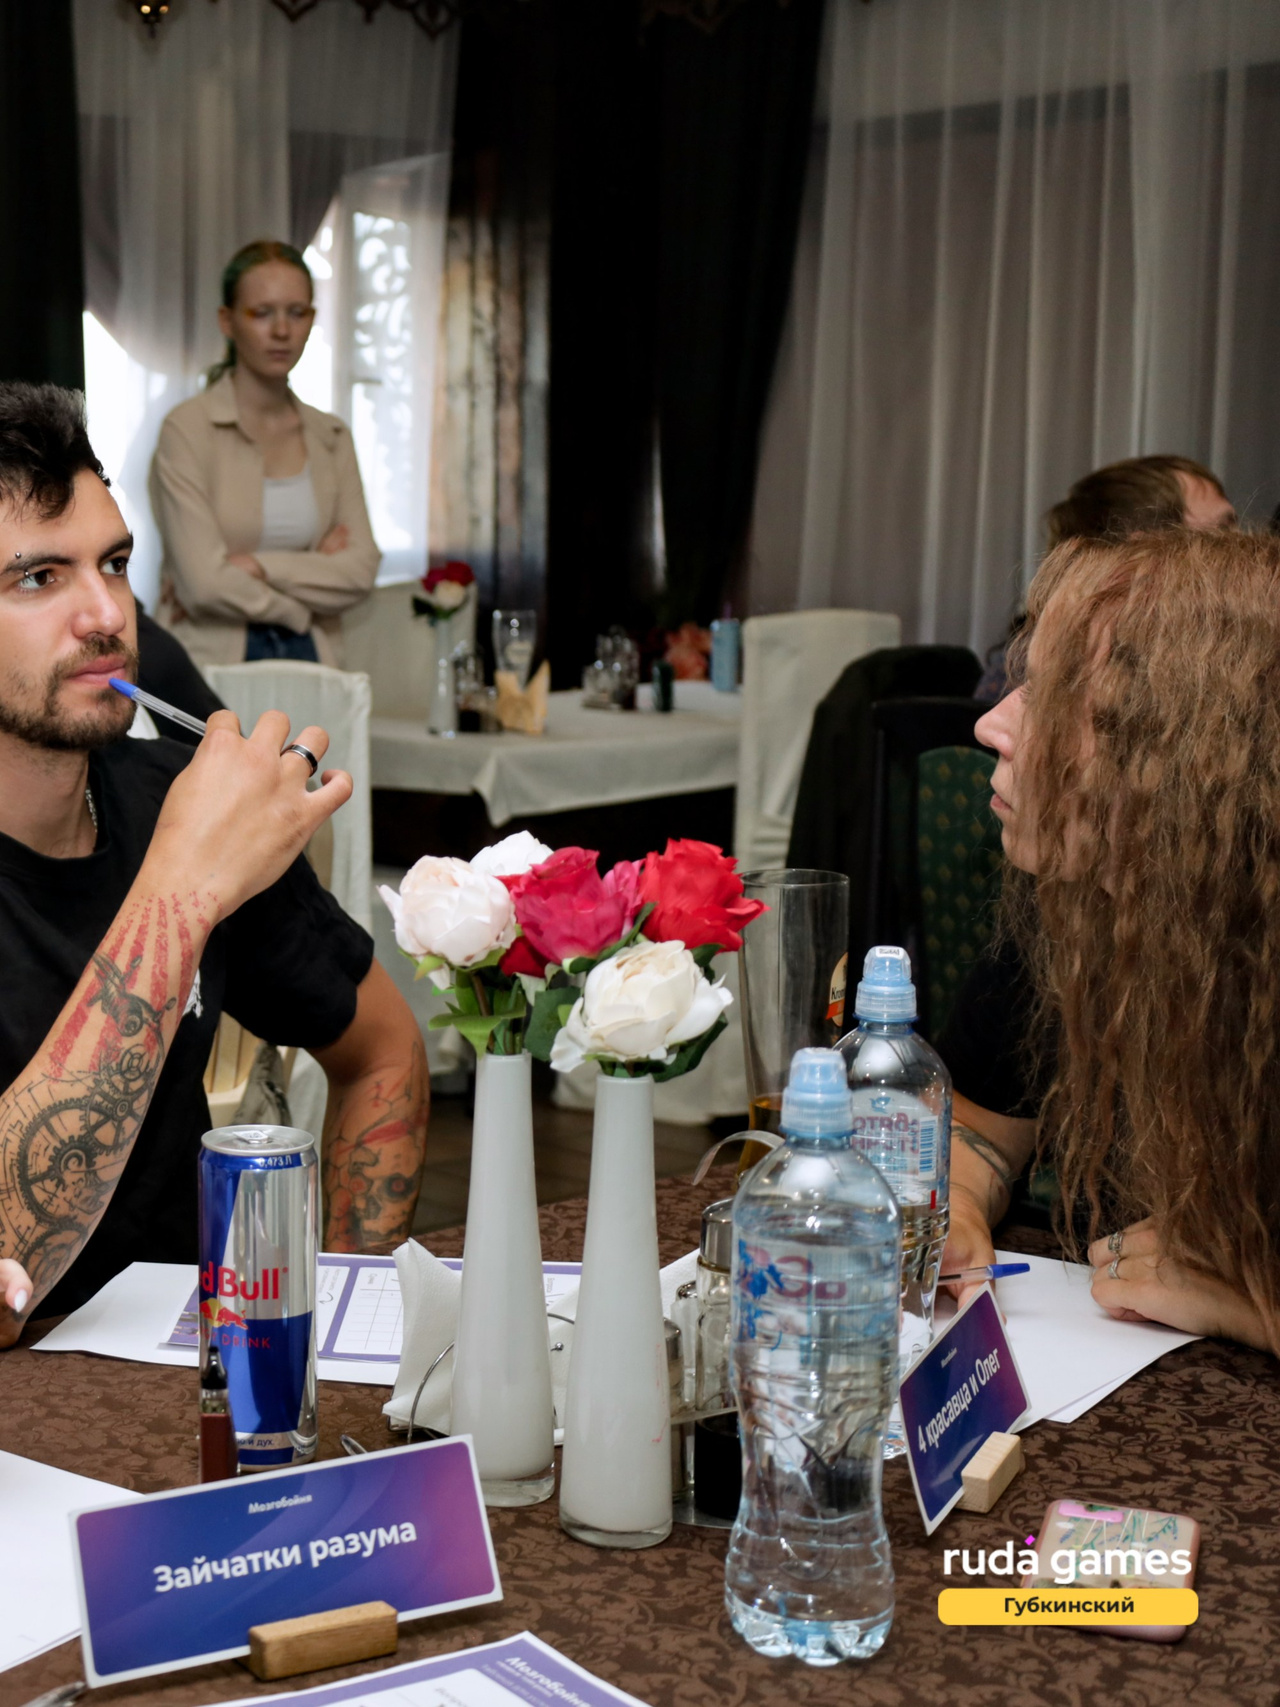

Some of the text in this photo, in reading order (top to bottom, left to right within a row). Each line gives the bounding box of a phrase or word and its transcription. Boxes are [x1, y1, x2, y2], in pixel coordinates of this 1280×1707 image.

[218, 1266, 279, 1300] Bull
[222, 1333, 271, 1349] DRINK
[918, 1424, 927, 1454] 4
[925, 1382, 973, 1449] красавца
[969, 1373, 980, 1397] и
[975, 1348, 1001, 1386] Олег
[153, 1522, 417, 1593] Зайчатки разума
